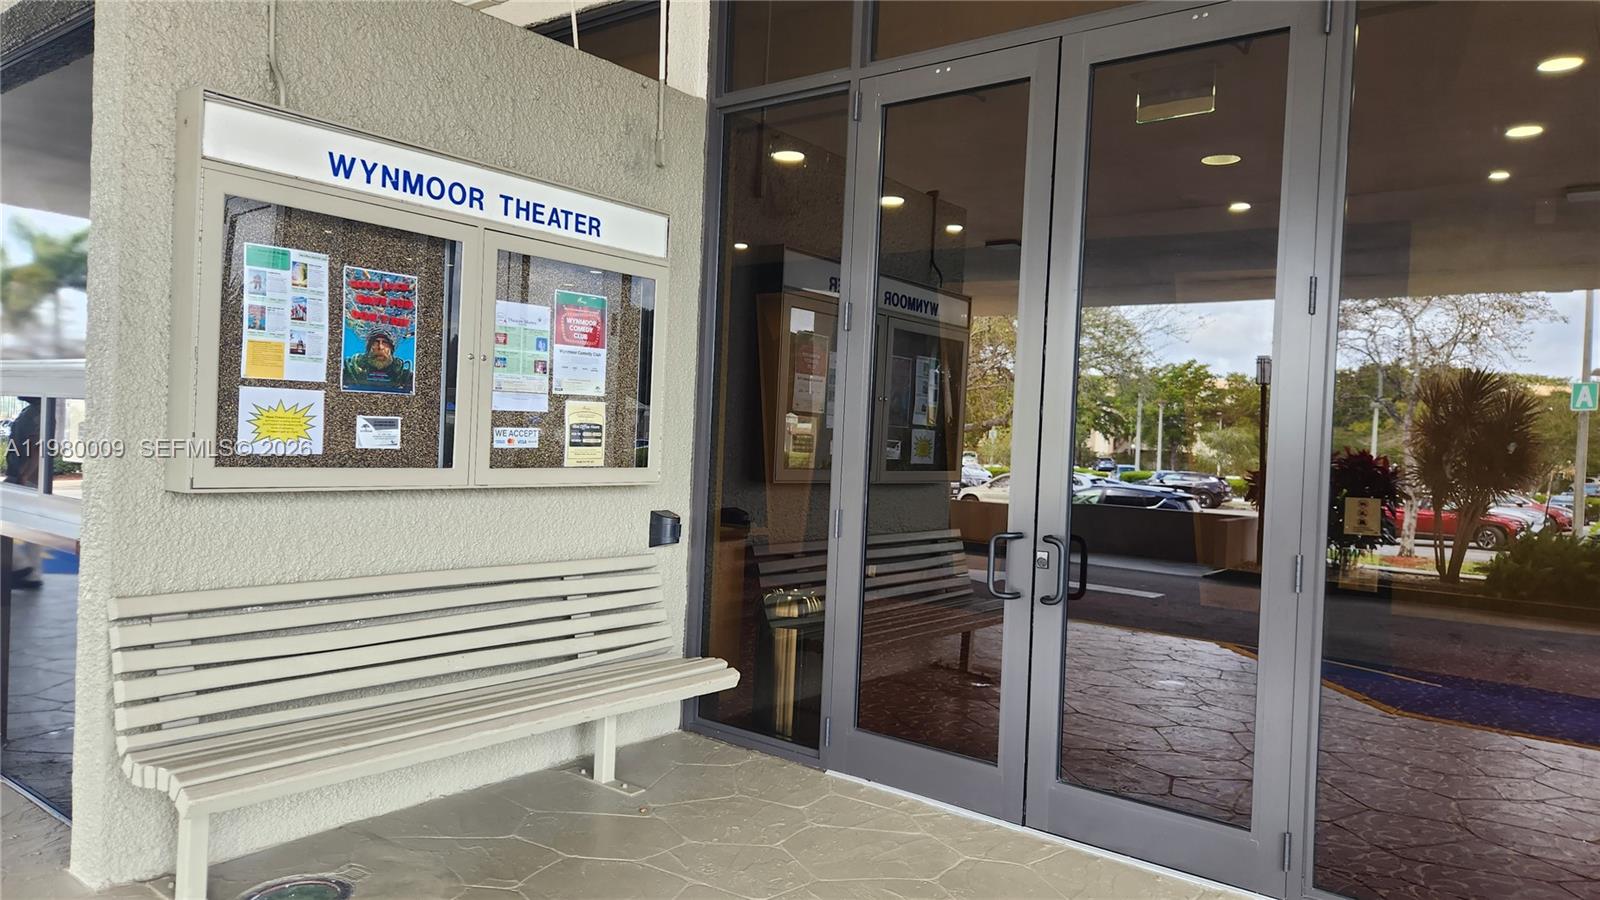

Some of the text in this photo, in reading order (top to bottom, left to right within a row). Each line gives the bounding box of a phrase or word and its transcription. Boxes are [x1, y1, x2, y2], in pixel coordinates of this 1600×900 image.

[328, 151, 601, 237] WYNMOOR THEATER
[566, 317, 597, 327] WYNMOOR
[569, 325, 594, 333] COMEDY
[1575, 384, 1593, 408] A
[495, 429, 537, 438] WE ACCEPT
